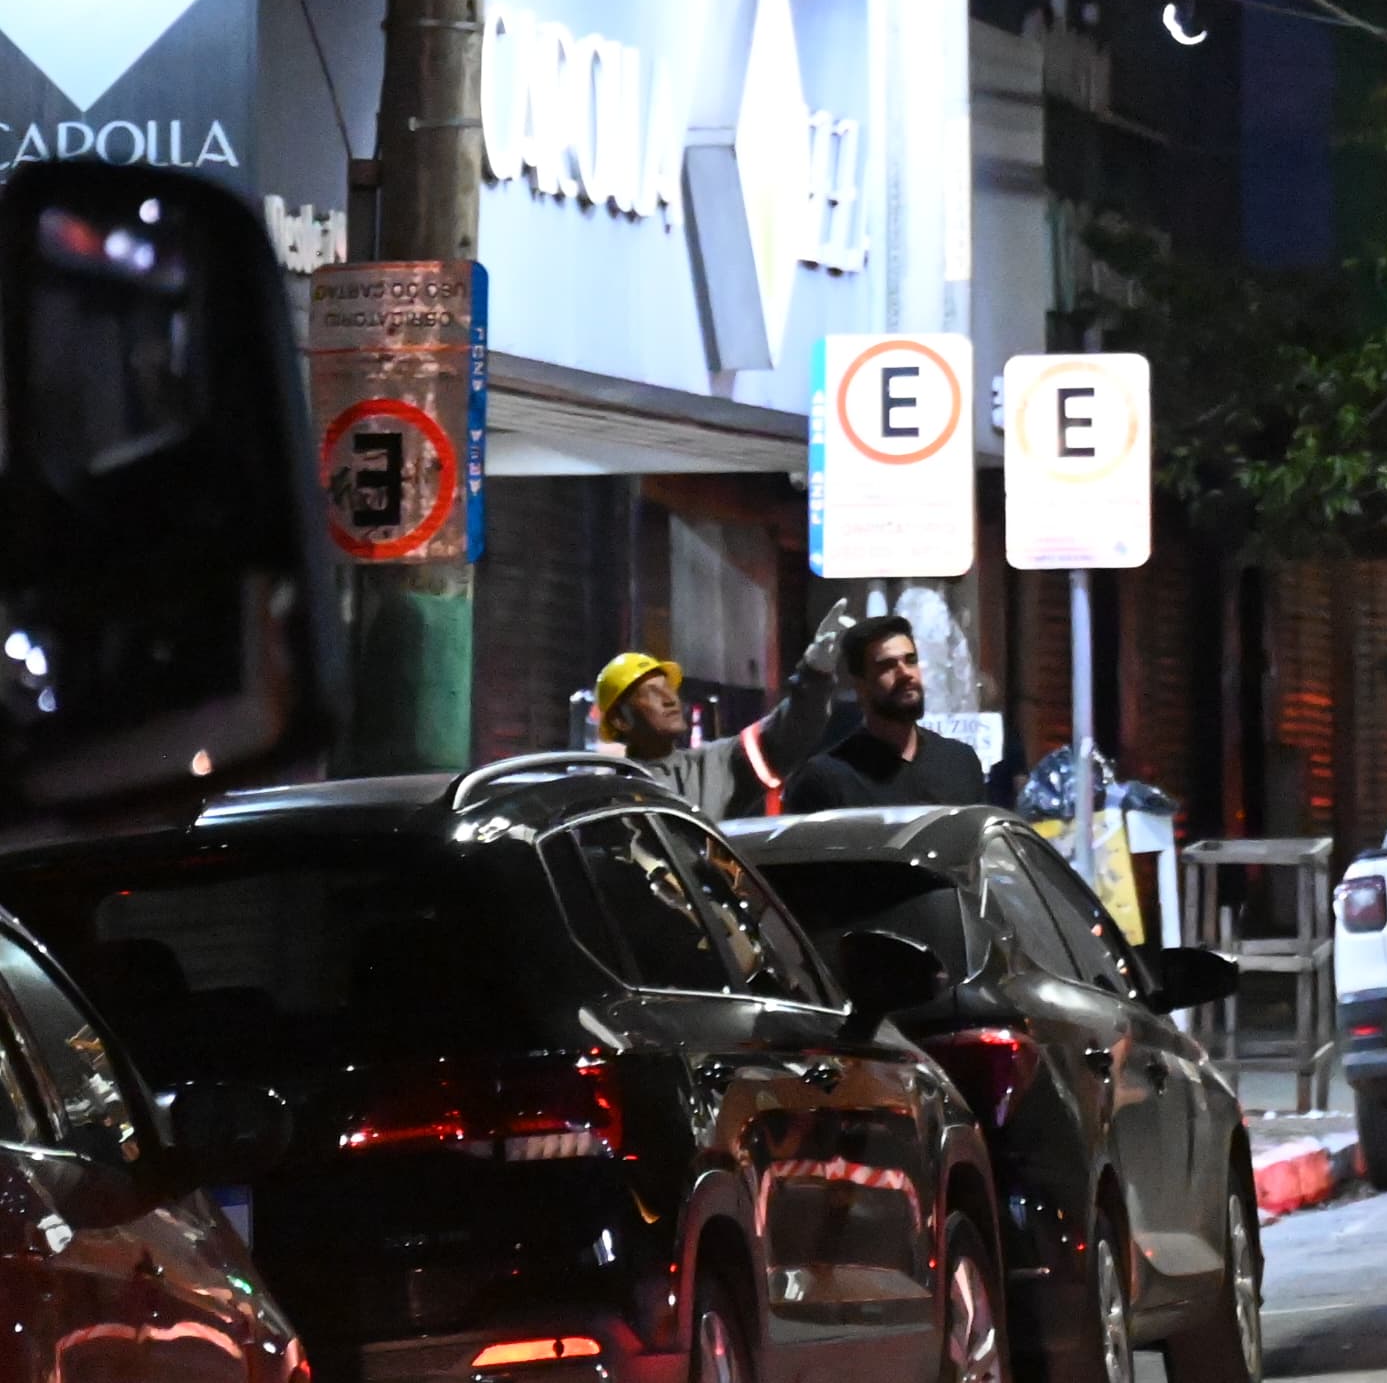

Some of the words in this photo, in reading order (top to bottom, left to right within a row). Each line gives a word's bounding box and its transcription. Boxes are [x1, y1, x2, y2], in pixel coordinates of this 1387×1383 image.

[0, 119, 240, 172] AROLLA
[881, 366, 920, 438] E
[1056, 387, 1096, 458] E
[353, 432, 404, 527] E
